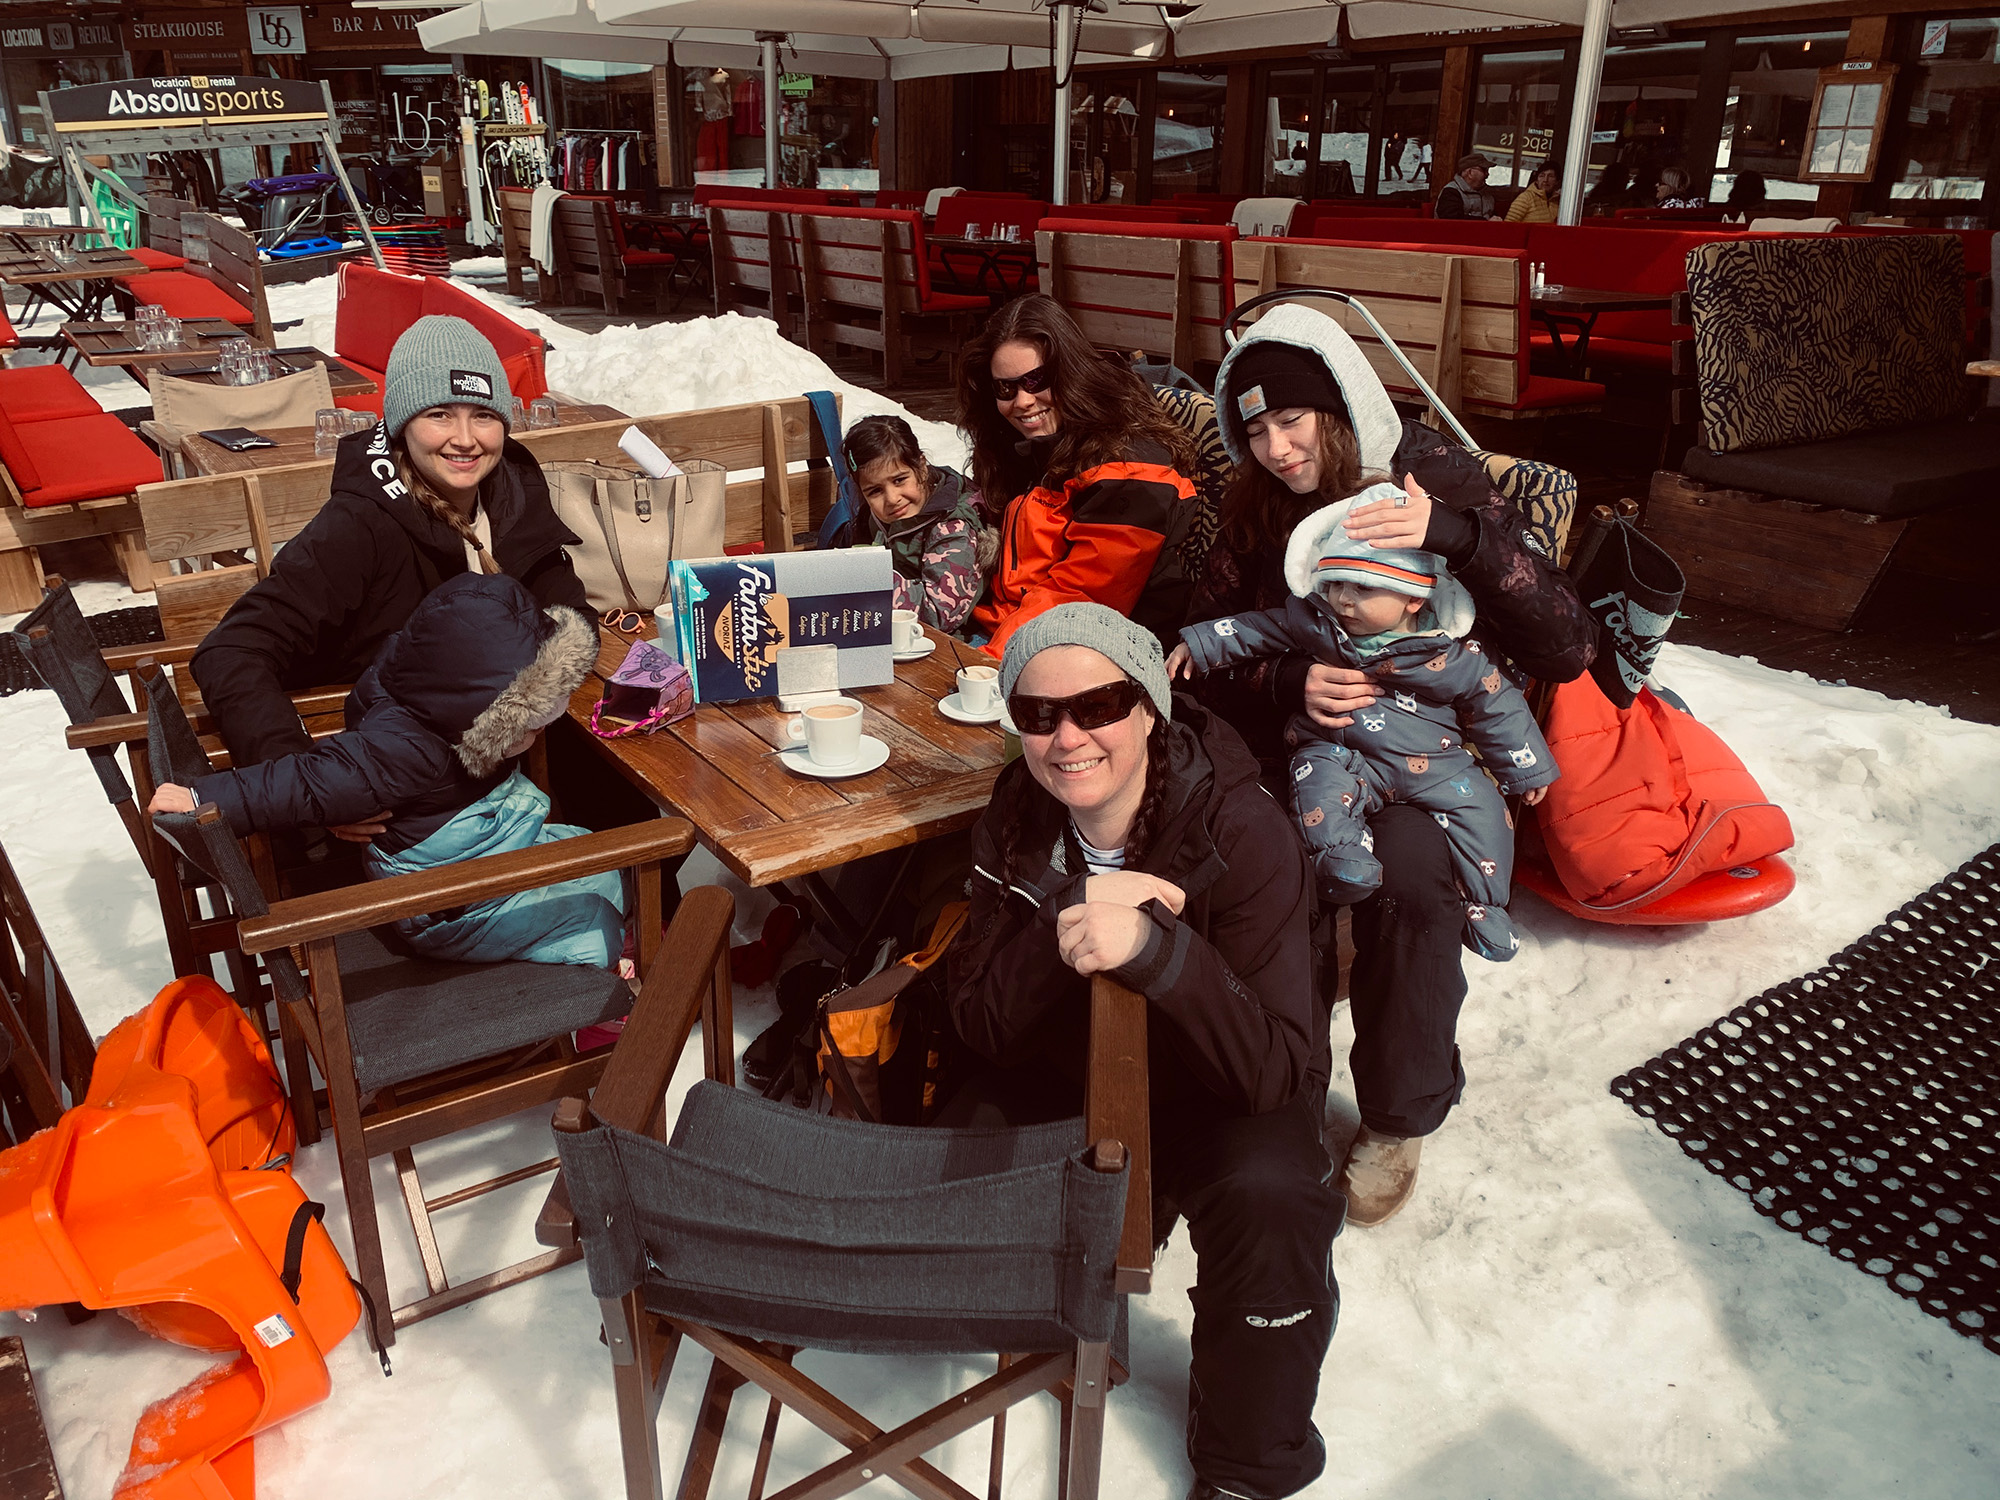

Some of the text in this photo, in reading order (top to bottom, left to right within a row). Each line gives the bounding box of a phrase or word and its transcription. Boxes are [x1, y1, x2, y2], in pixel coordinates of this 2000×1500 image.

[133, 21, 224, 39] STEAKHOUSE
[332, 15, 420, 32] BAR A VIN
[1, 25, 114, 47] LOCATION SKI RENTAL
[151, 77, 236, 88] location ski rental
[108, 87, 285, 117] Absolu sports
[453, 379, 479, 388] NORTH
[463, 374, 479, 382] THE
[462, 384, 480, 392] FACE
[759, 592, 774, 607] le
[722, 615, 731, 650] AVORIAZ
